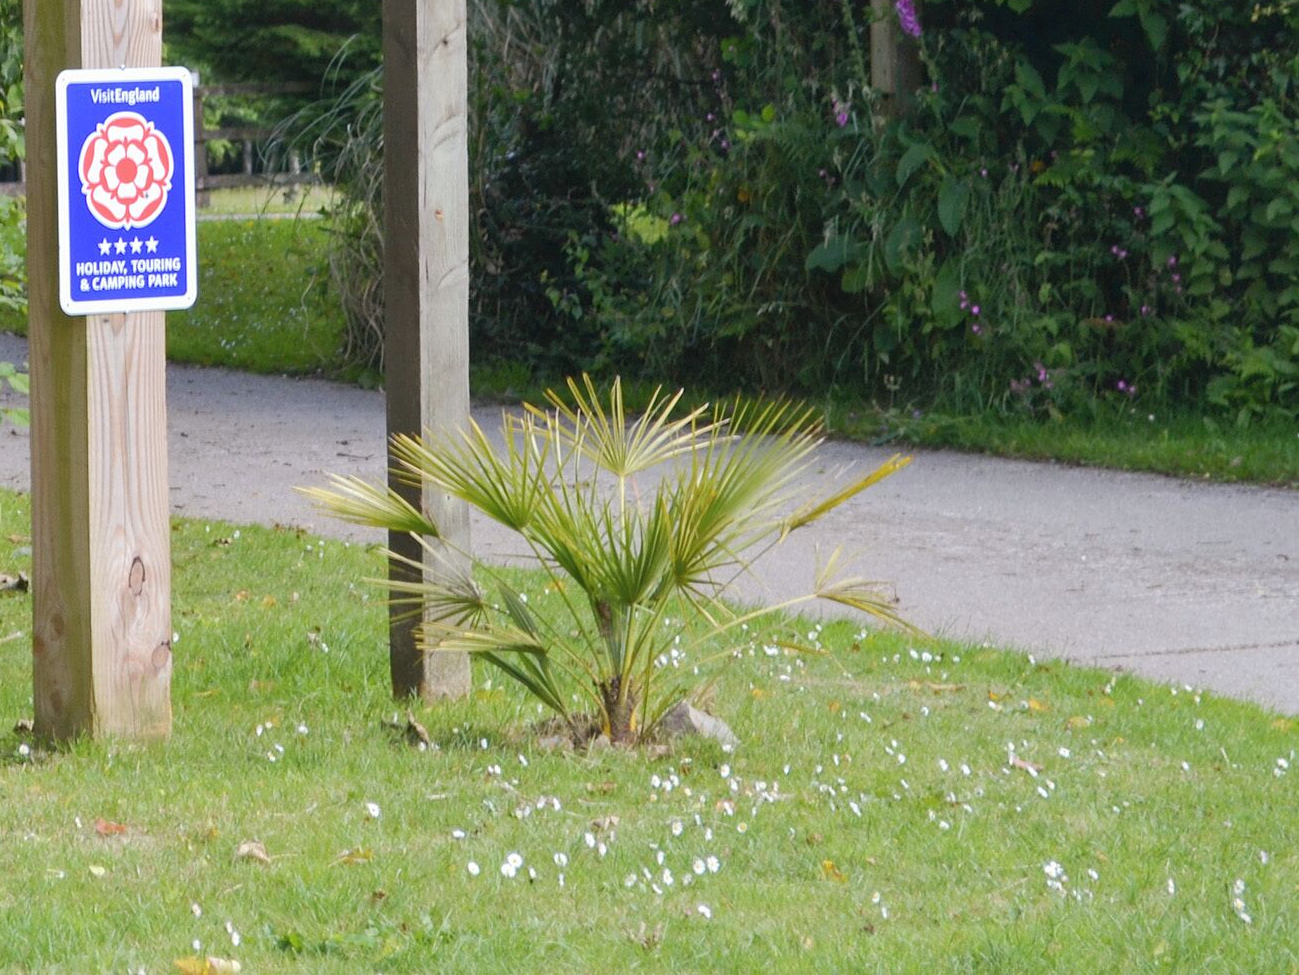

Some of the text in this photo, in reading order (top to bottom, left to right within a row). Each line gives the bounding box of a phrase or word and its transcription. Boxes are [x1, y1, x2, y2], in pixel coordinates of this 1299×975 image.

[90, 86, 160, 106] VisitEngland
[76, 257, 181, 276] HOLIDAY, TOURING
[80, 273, 178, 292] & CAMPING PARK
